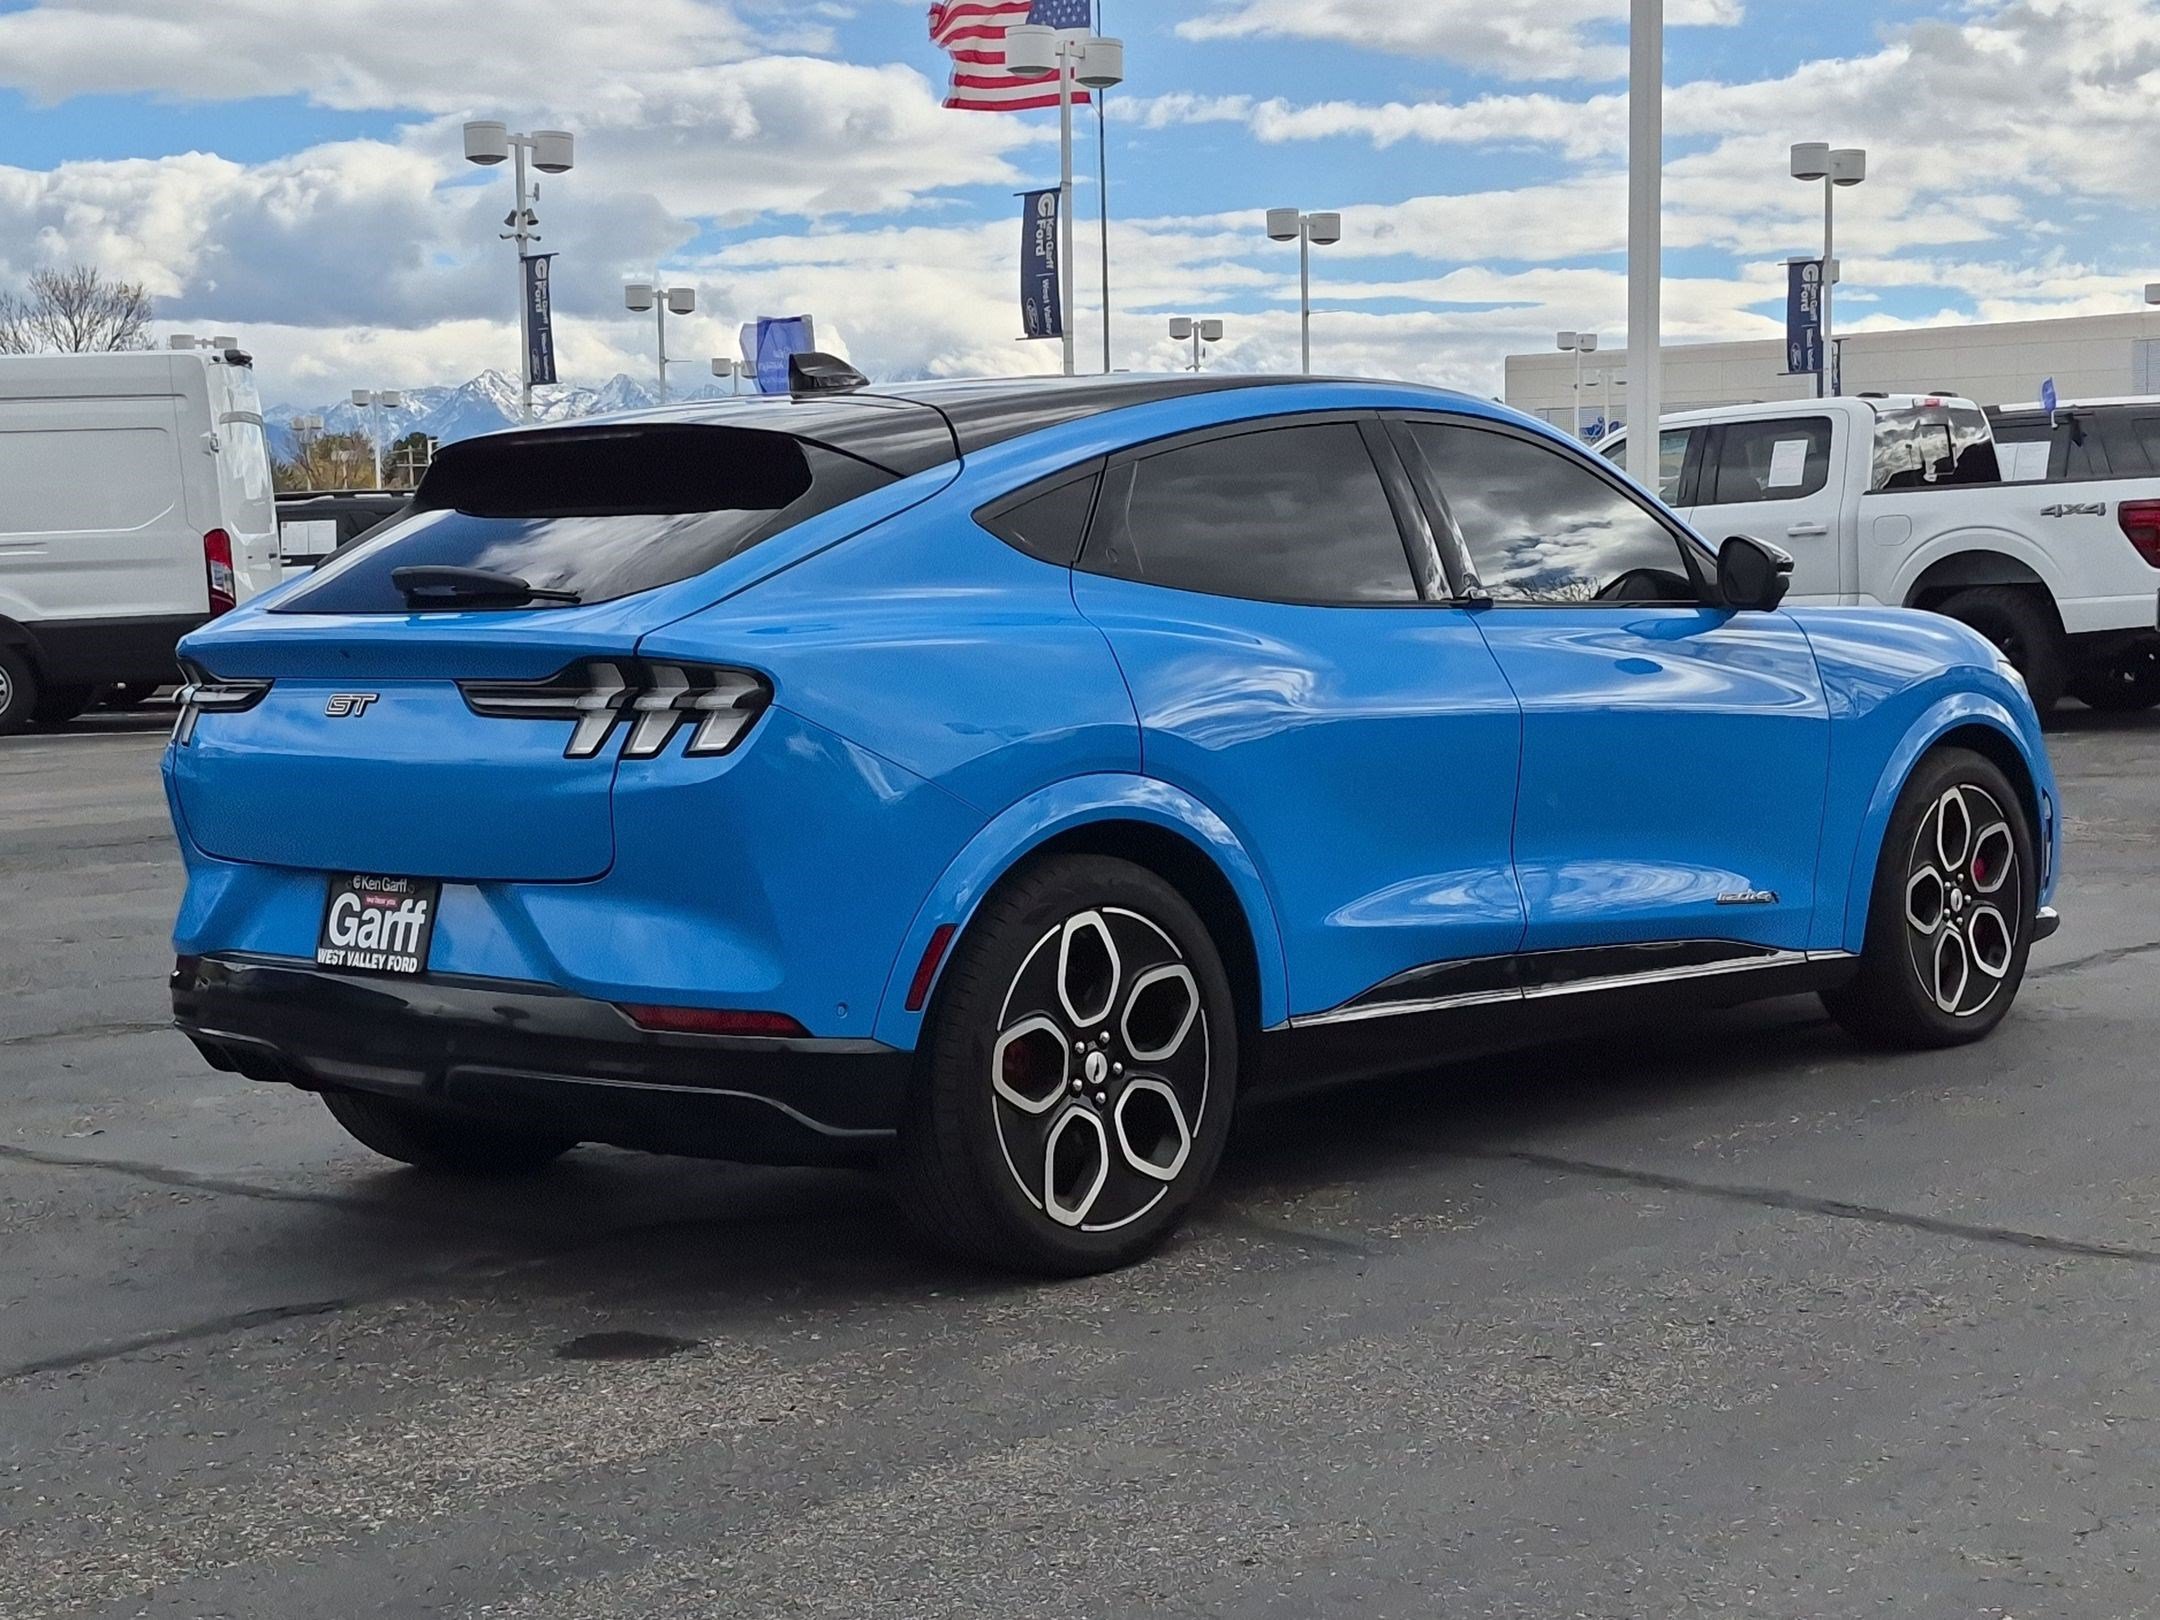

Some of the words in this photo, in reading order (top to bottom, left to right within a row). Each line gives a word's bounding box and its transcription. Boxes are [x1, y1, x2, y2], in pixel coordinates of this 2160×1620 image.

[1035, 219, 1046, 256] Ford
[1046, 218, 1055, 240] Ken
[1046, 241, 1055, 269] Garff
[534, 281, 542, 312] Ford
[1042, 279, 1050, 303] West
[1800, 284, 1810, 312] Ford
[325, 693, 379, 717] GT
[361, 876, 381, 891] Ken
[328, 892, 427, 953] Garff
[317, 948, 346, 965] WEST
[346, 951, 387, 970] VALLEY
[387, 955, 418, 973] FORD
